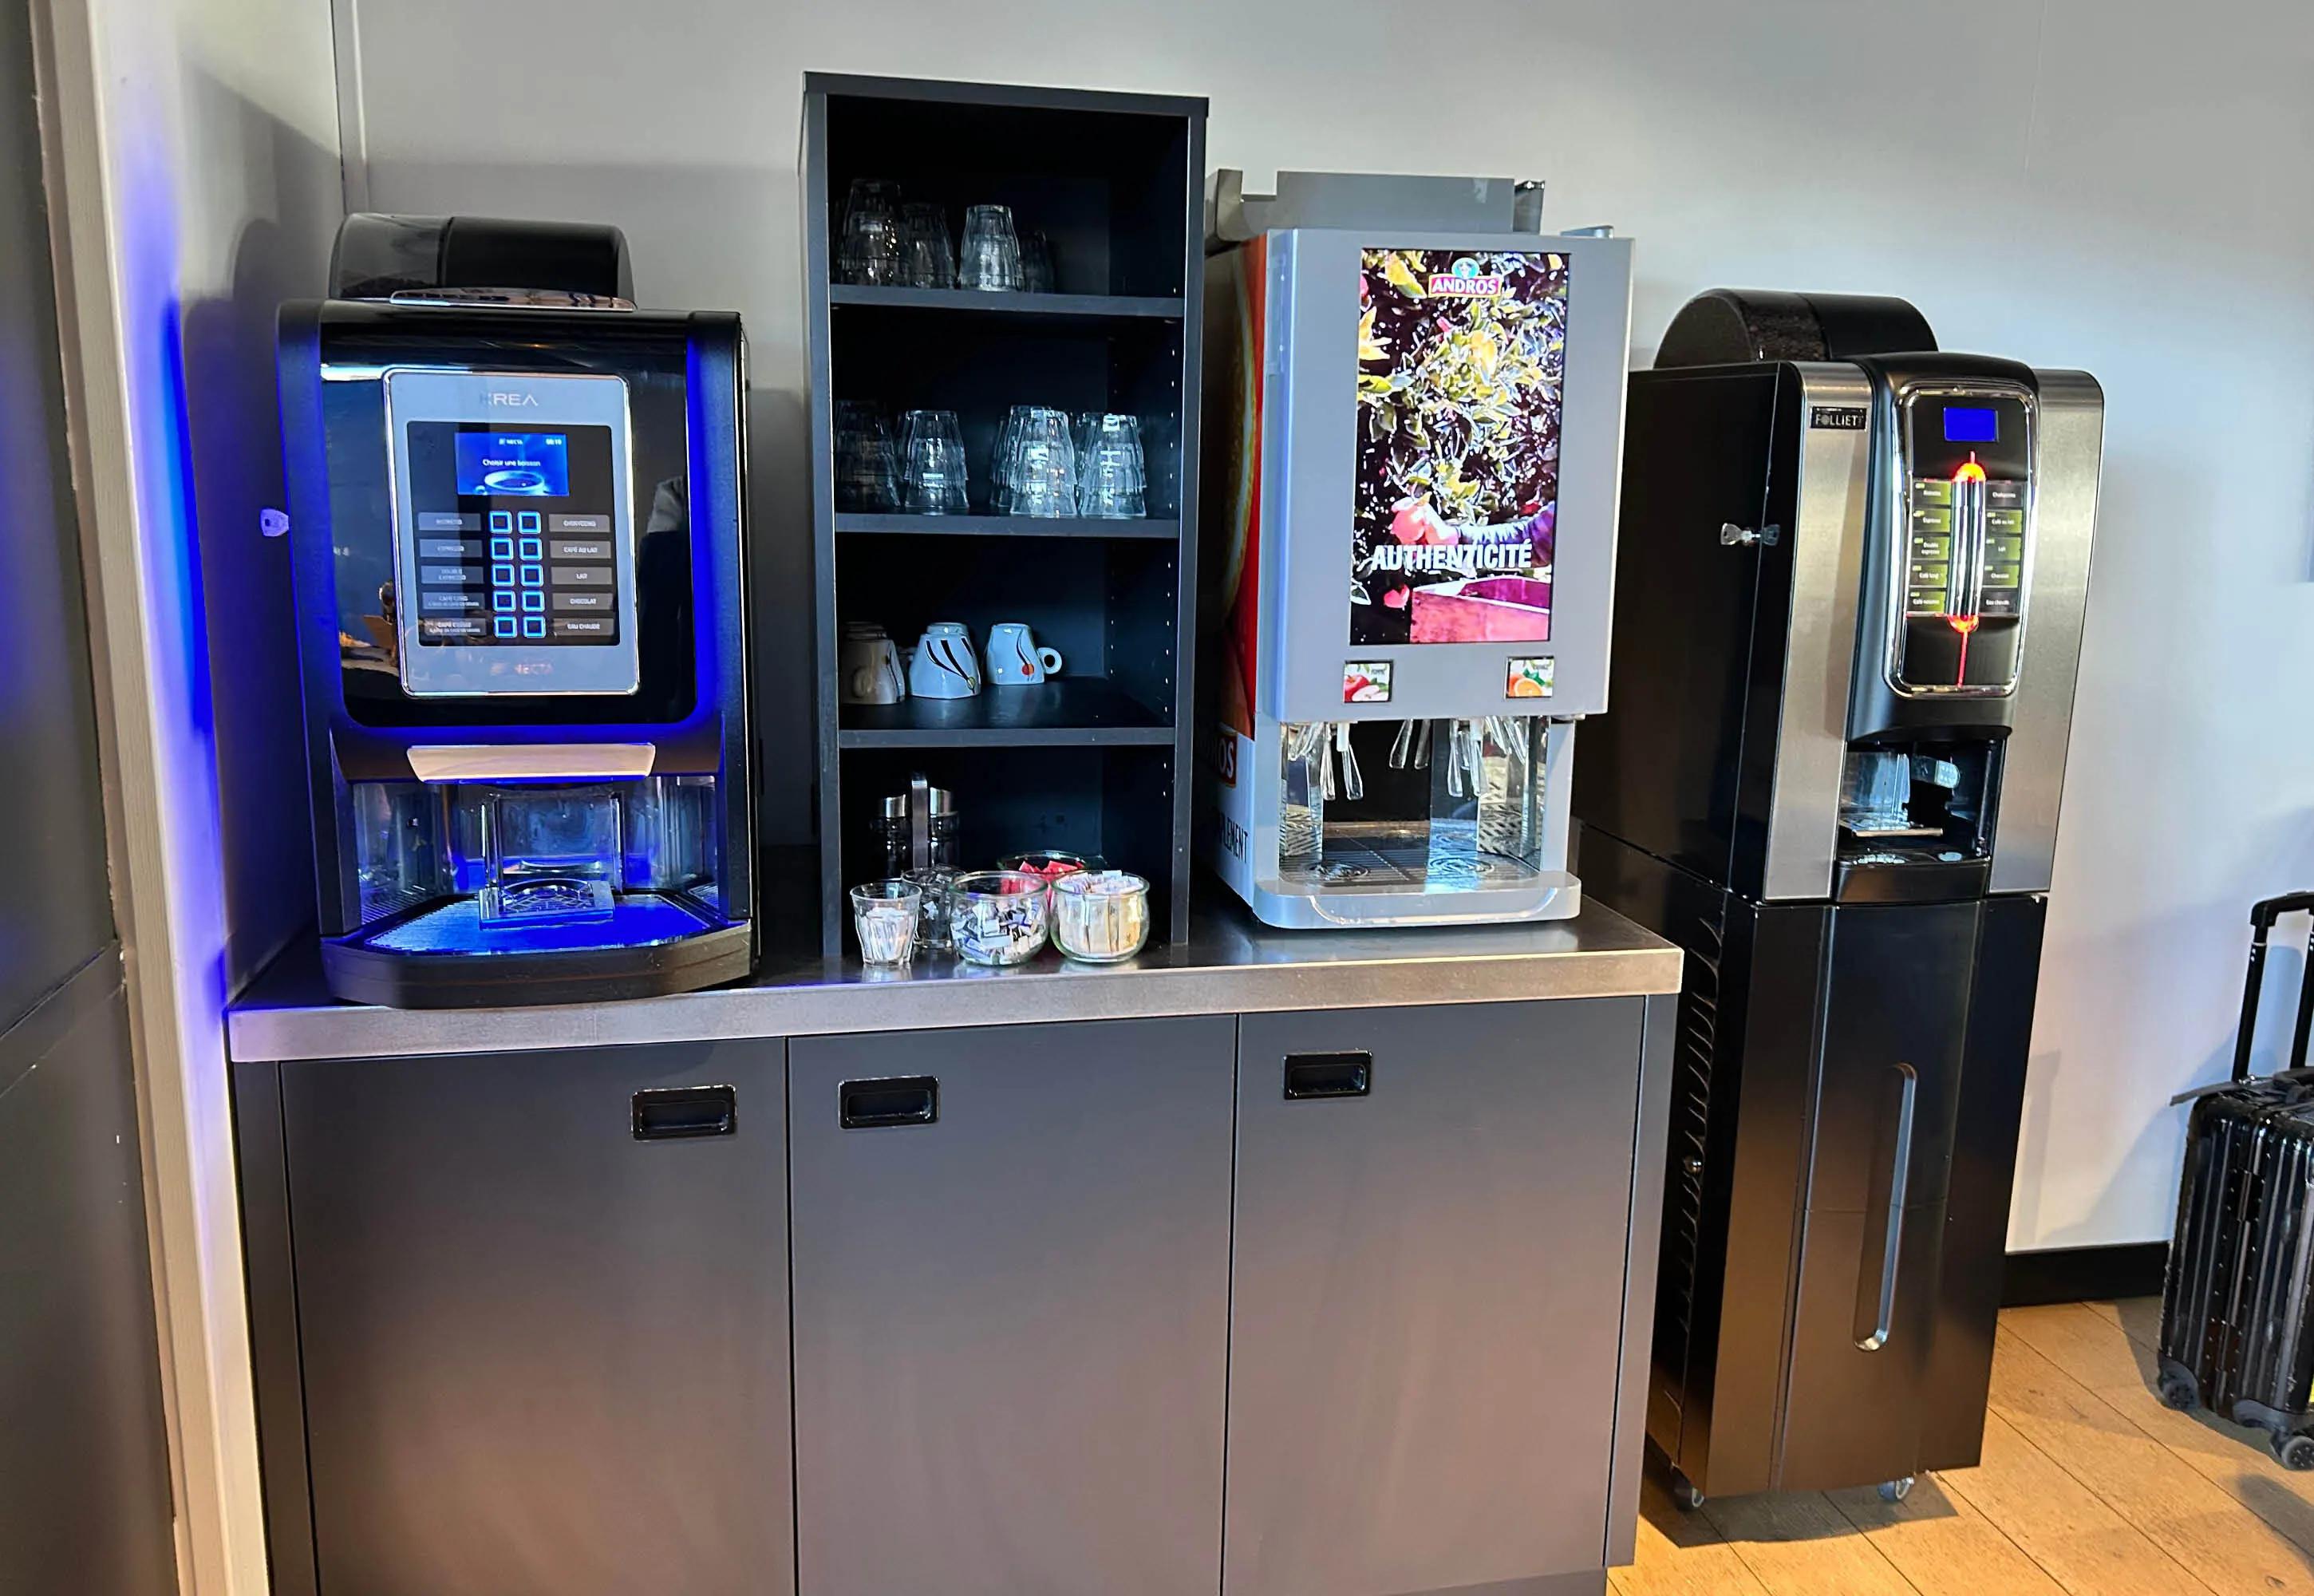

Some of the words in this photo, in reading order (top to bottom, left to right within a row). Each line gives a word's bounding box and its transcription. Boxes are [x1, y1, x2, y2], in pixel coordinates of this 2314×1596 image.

[1431, 278, 1497, 294] ANDROS
[1815, 413, 1858, 426] FOLLIET
[1372, 539, 1532, 570] AUTHENTICITÉ
